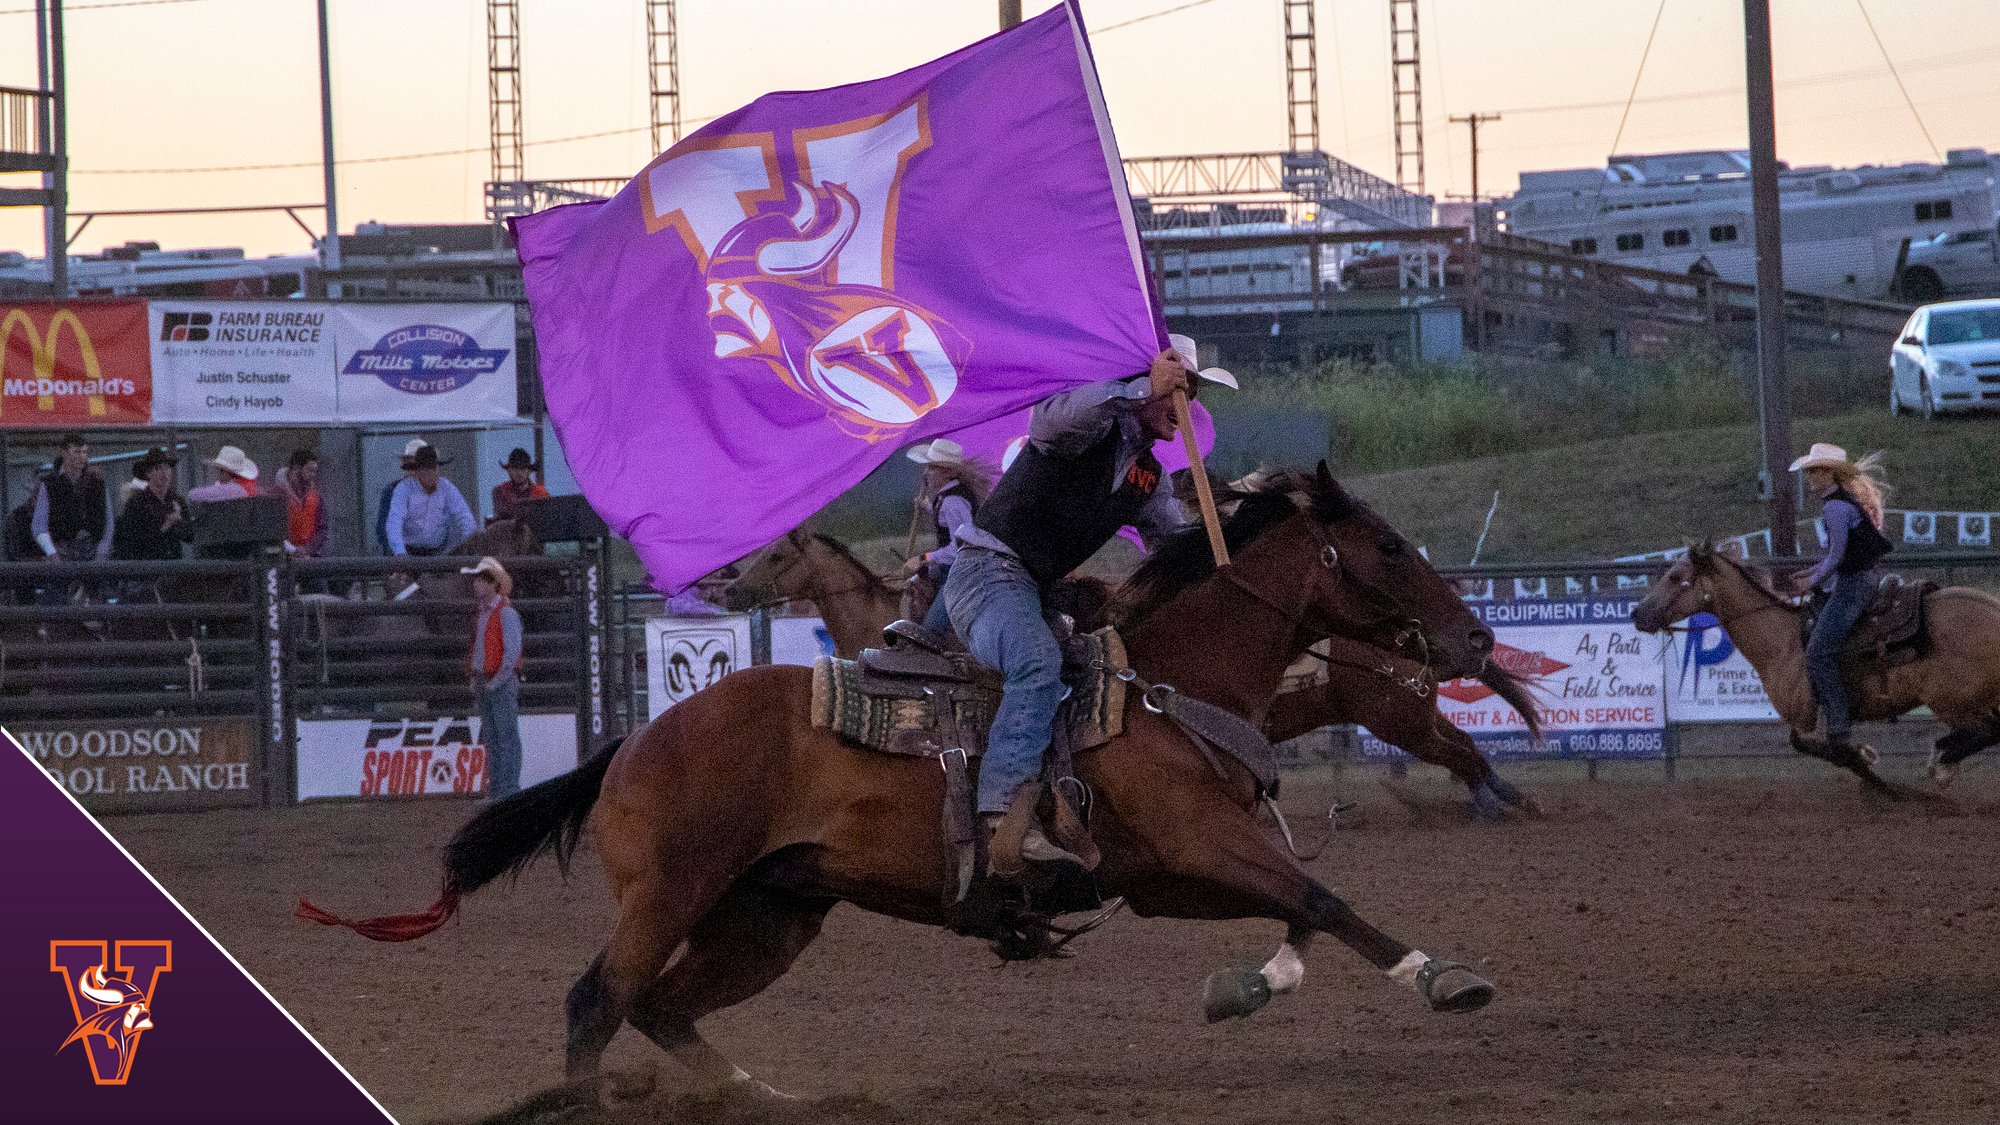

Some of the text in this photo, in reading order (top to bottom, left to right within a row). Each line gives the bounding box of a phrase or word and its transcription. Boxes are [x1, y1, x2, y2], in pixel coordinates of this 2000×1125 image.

[218, 312, 324, 326] FARM BUREAU
[215, 328, 321, 343] INSURANCE
[388, 328, 466, 349] COLLISION
[162, 347, 315, 357] Auto Home Life Health
[359, 353, 496, 370] Mills Motors
[196, 371, 291, 384] Justin Schuster
[400, 376, 456, 392] CENTER
[4, 378, 135, 396] McDonald's
[205, 395, 284, 410] Cindy Hayob
[1486, 603, 1588, 621] EQUIPMENT
[1592, 602, 1640, 619] SALE
[1576, 633, 1599, 662] Ag
[1606, 632, 1641, 656] Parts
[1601, 656, 1617, 676] &
[1709, 668, 1747, 680] Prime
[1562, 675, 1656, 698] Field Service
[1717, 682, 1761, 695] & Exca
[1447, 710, 1487, 727] MENT
[1492, 710, 1502, 725] &
[1584, 706, 1655, 724] SERVICE
[364, 719, 481, 749] PEA
[20, 728, 202, 759] WOODSON
[49, 763, 249, 794] OOL RANCH
[360, 750, 432, 795] SPORT
